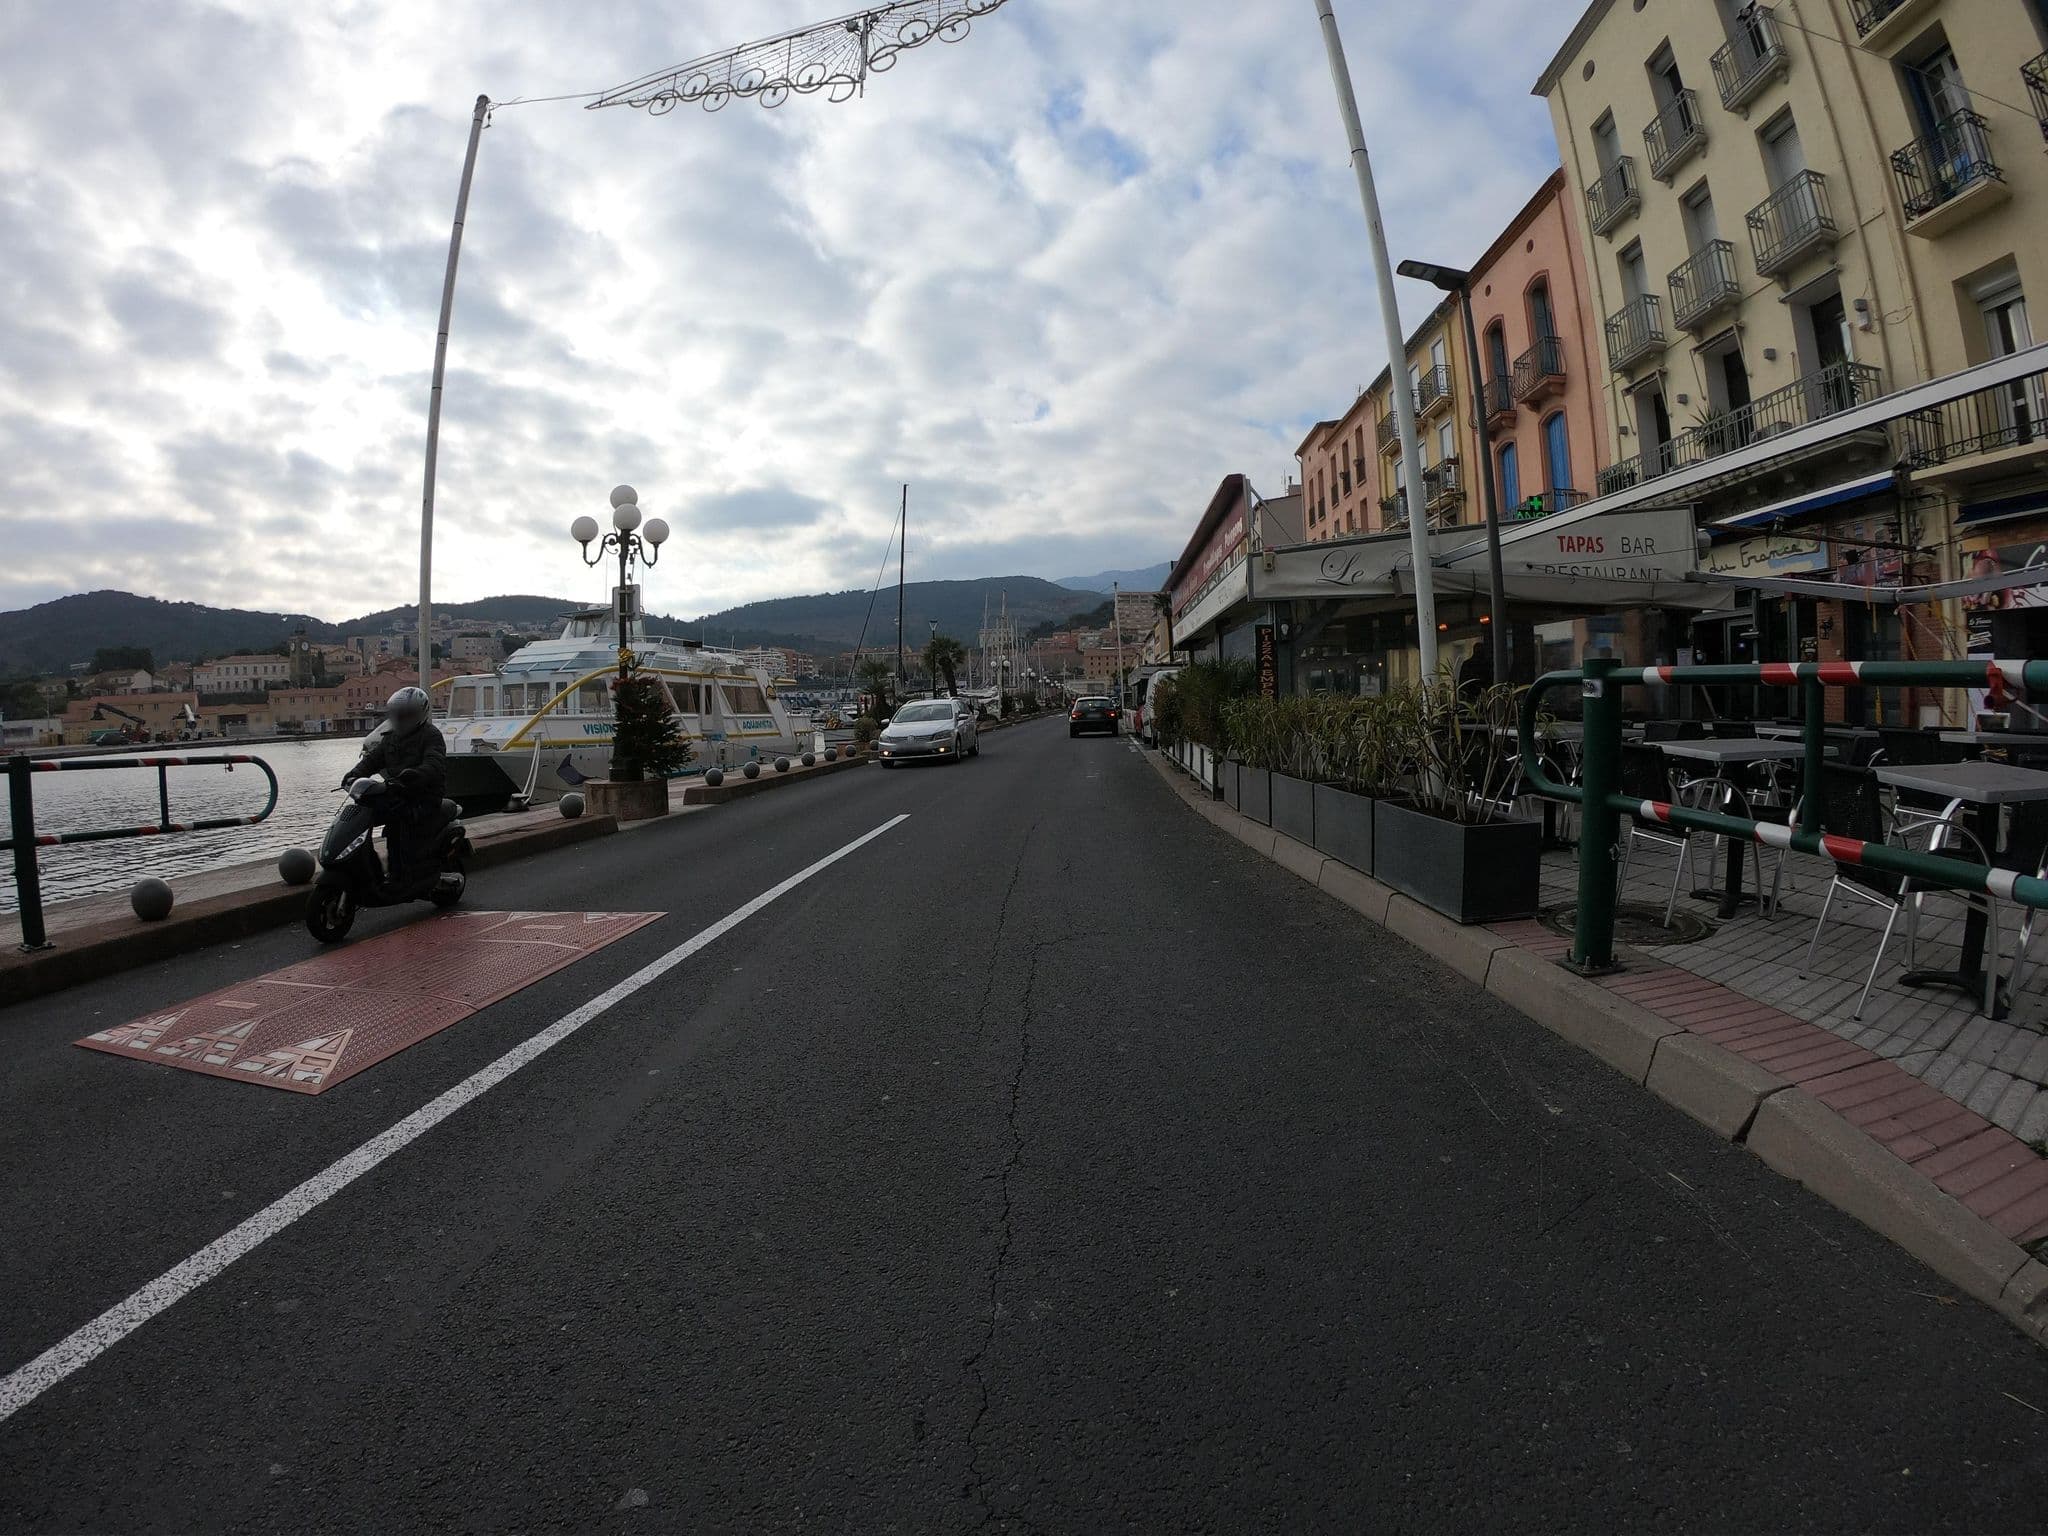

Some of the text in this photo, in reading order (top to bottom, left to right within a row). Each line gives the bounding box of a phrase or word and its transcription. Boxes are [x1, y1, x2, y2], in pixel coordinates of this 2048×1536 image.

[1557, 535, 1656, 554] TAPAS BAR
[1315, 549, 1365, 586] Le
[1709, 554, 1735, 573] du
[1261, 628, 1272, 660] PIZZA
